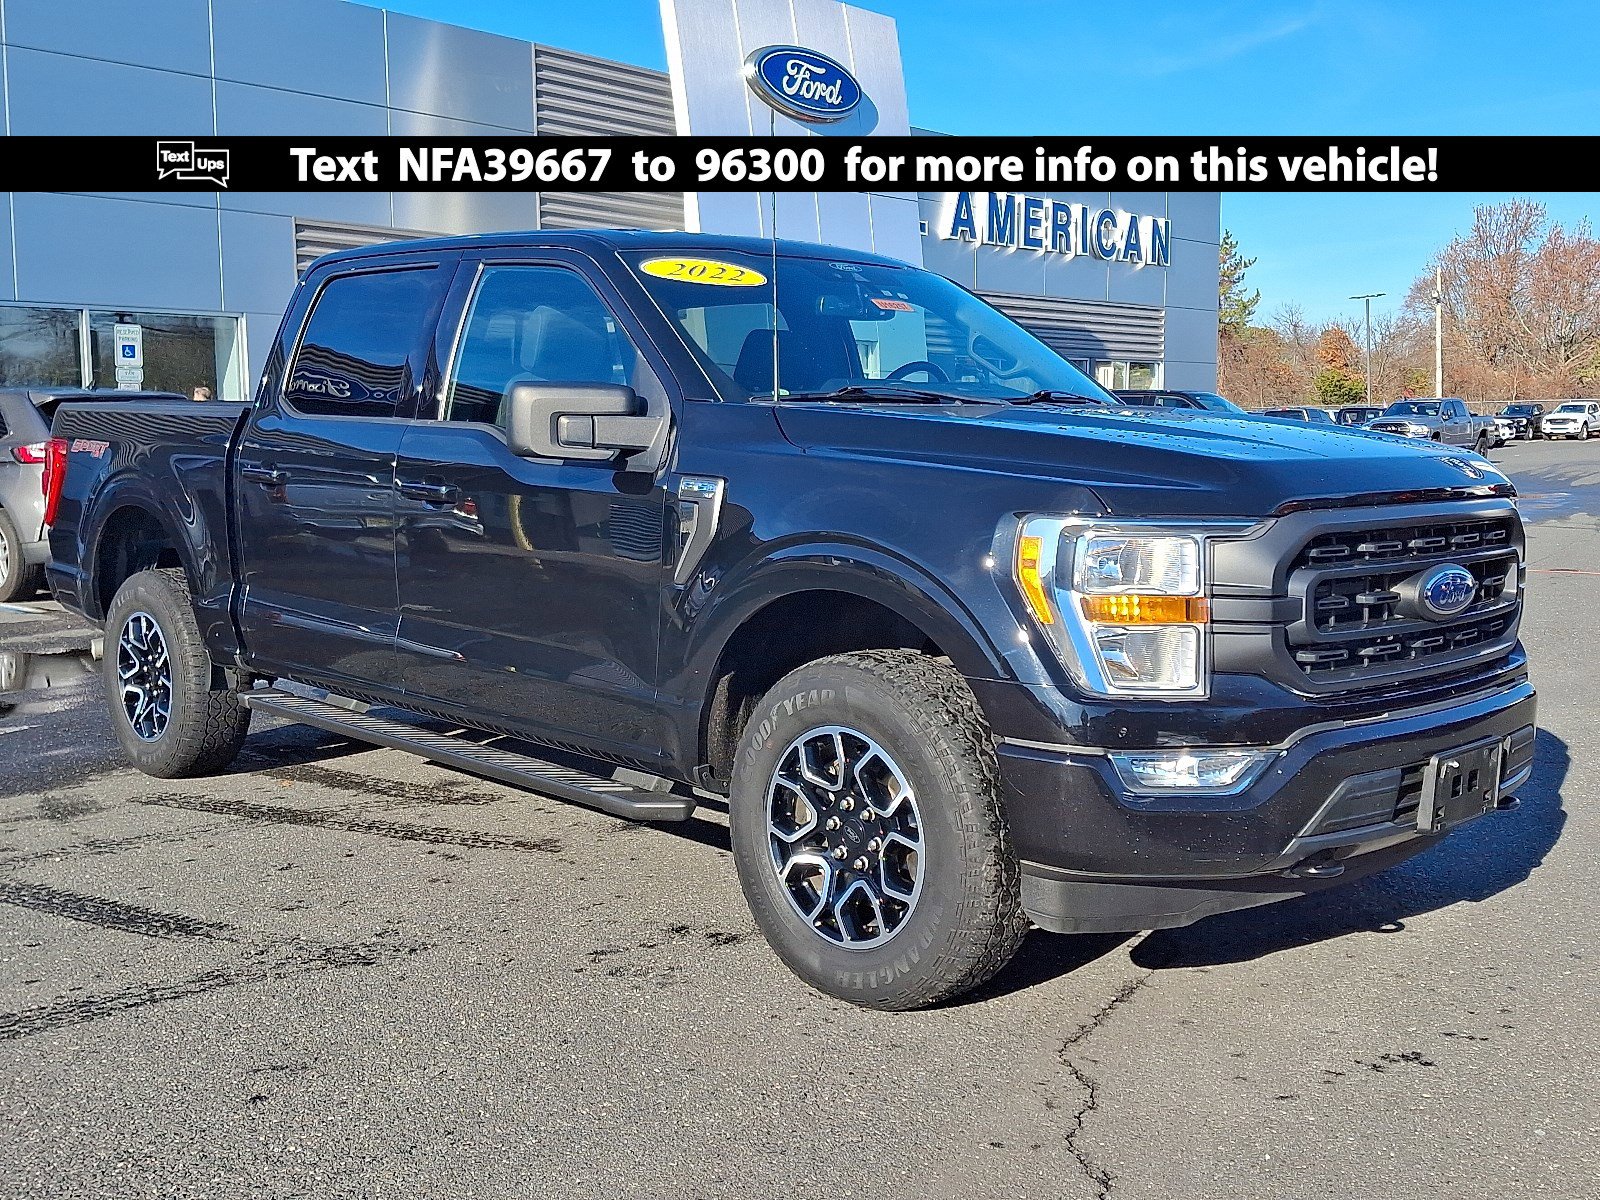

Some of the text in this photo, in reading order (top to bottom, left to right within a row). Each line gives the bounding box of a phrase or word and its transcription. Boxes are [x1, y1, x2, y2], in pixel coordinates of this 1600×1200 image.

[783, 59, 843, 105] Ford
[950, 192, 1171, 267] AMERICAN
[667, 263, 746, 282] 2022
[1439, 578, 1467, 605] Ford
